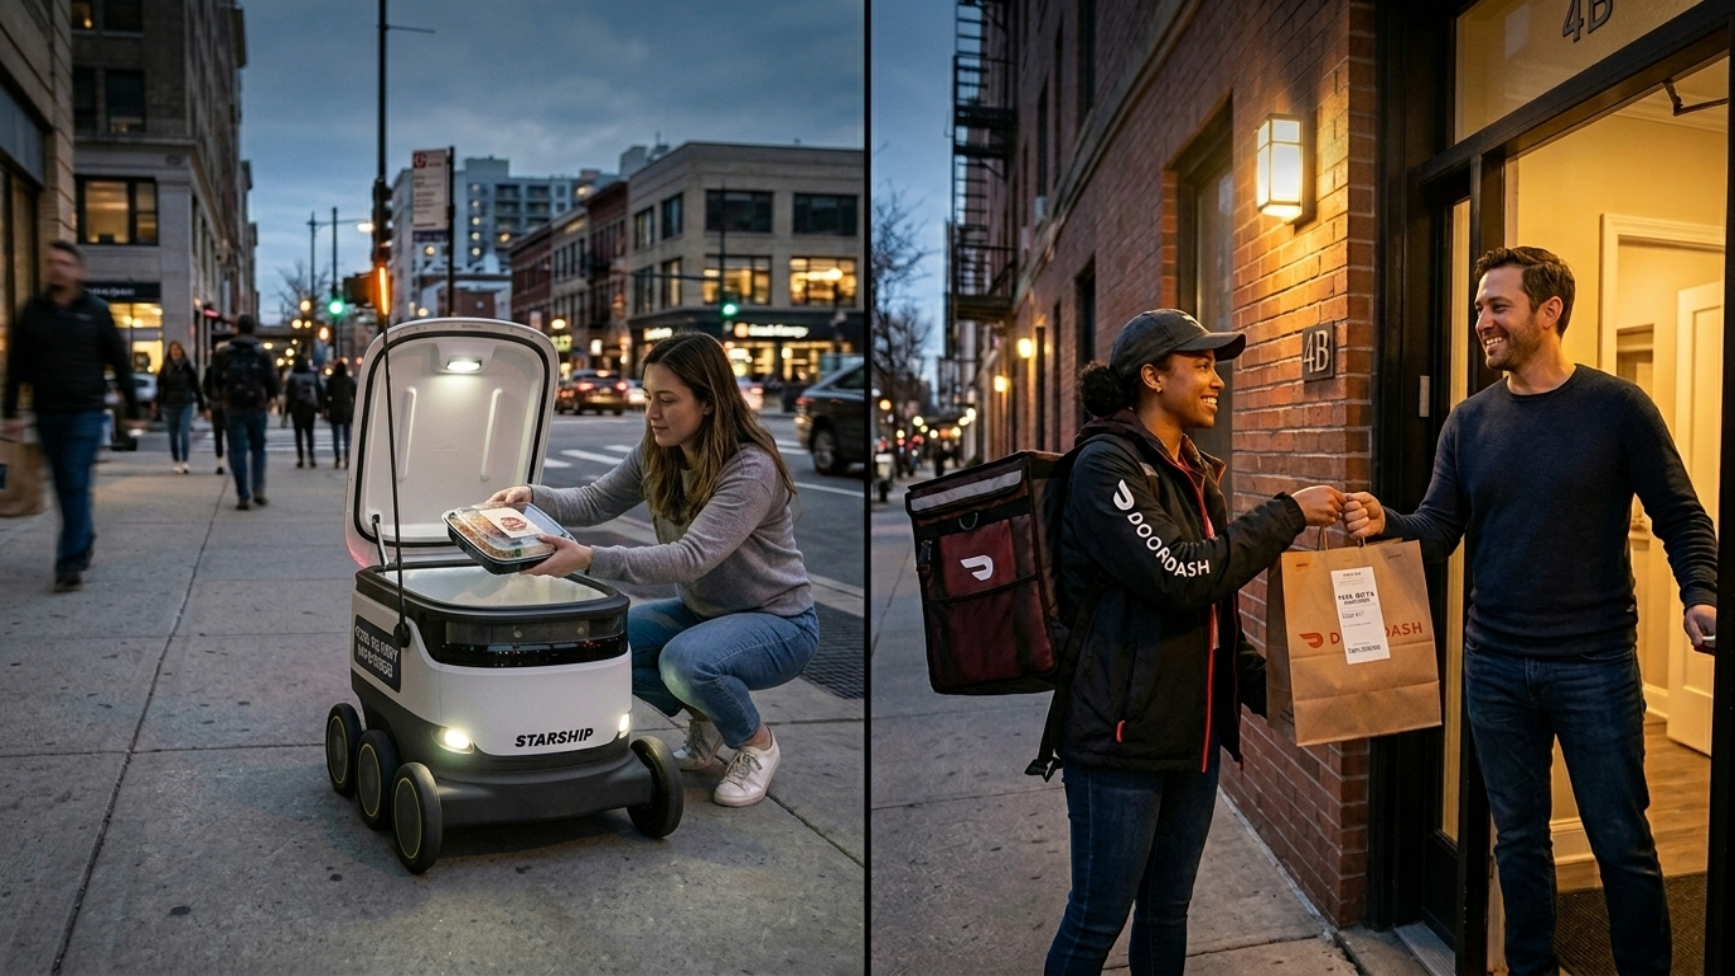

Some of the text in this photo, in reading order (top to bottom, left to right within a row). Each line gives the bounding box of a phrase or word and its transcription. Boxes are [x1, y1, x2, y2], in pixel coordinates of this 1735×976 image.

[1563, 0, 1613, 43] 4B
[1303, 329, 1329, 373] 4B
[1127, 512, 1211, 577] DOORDASH
[515, 727, 594, 748] STARSHIP
